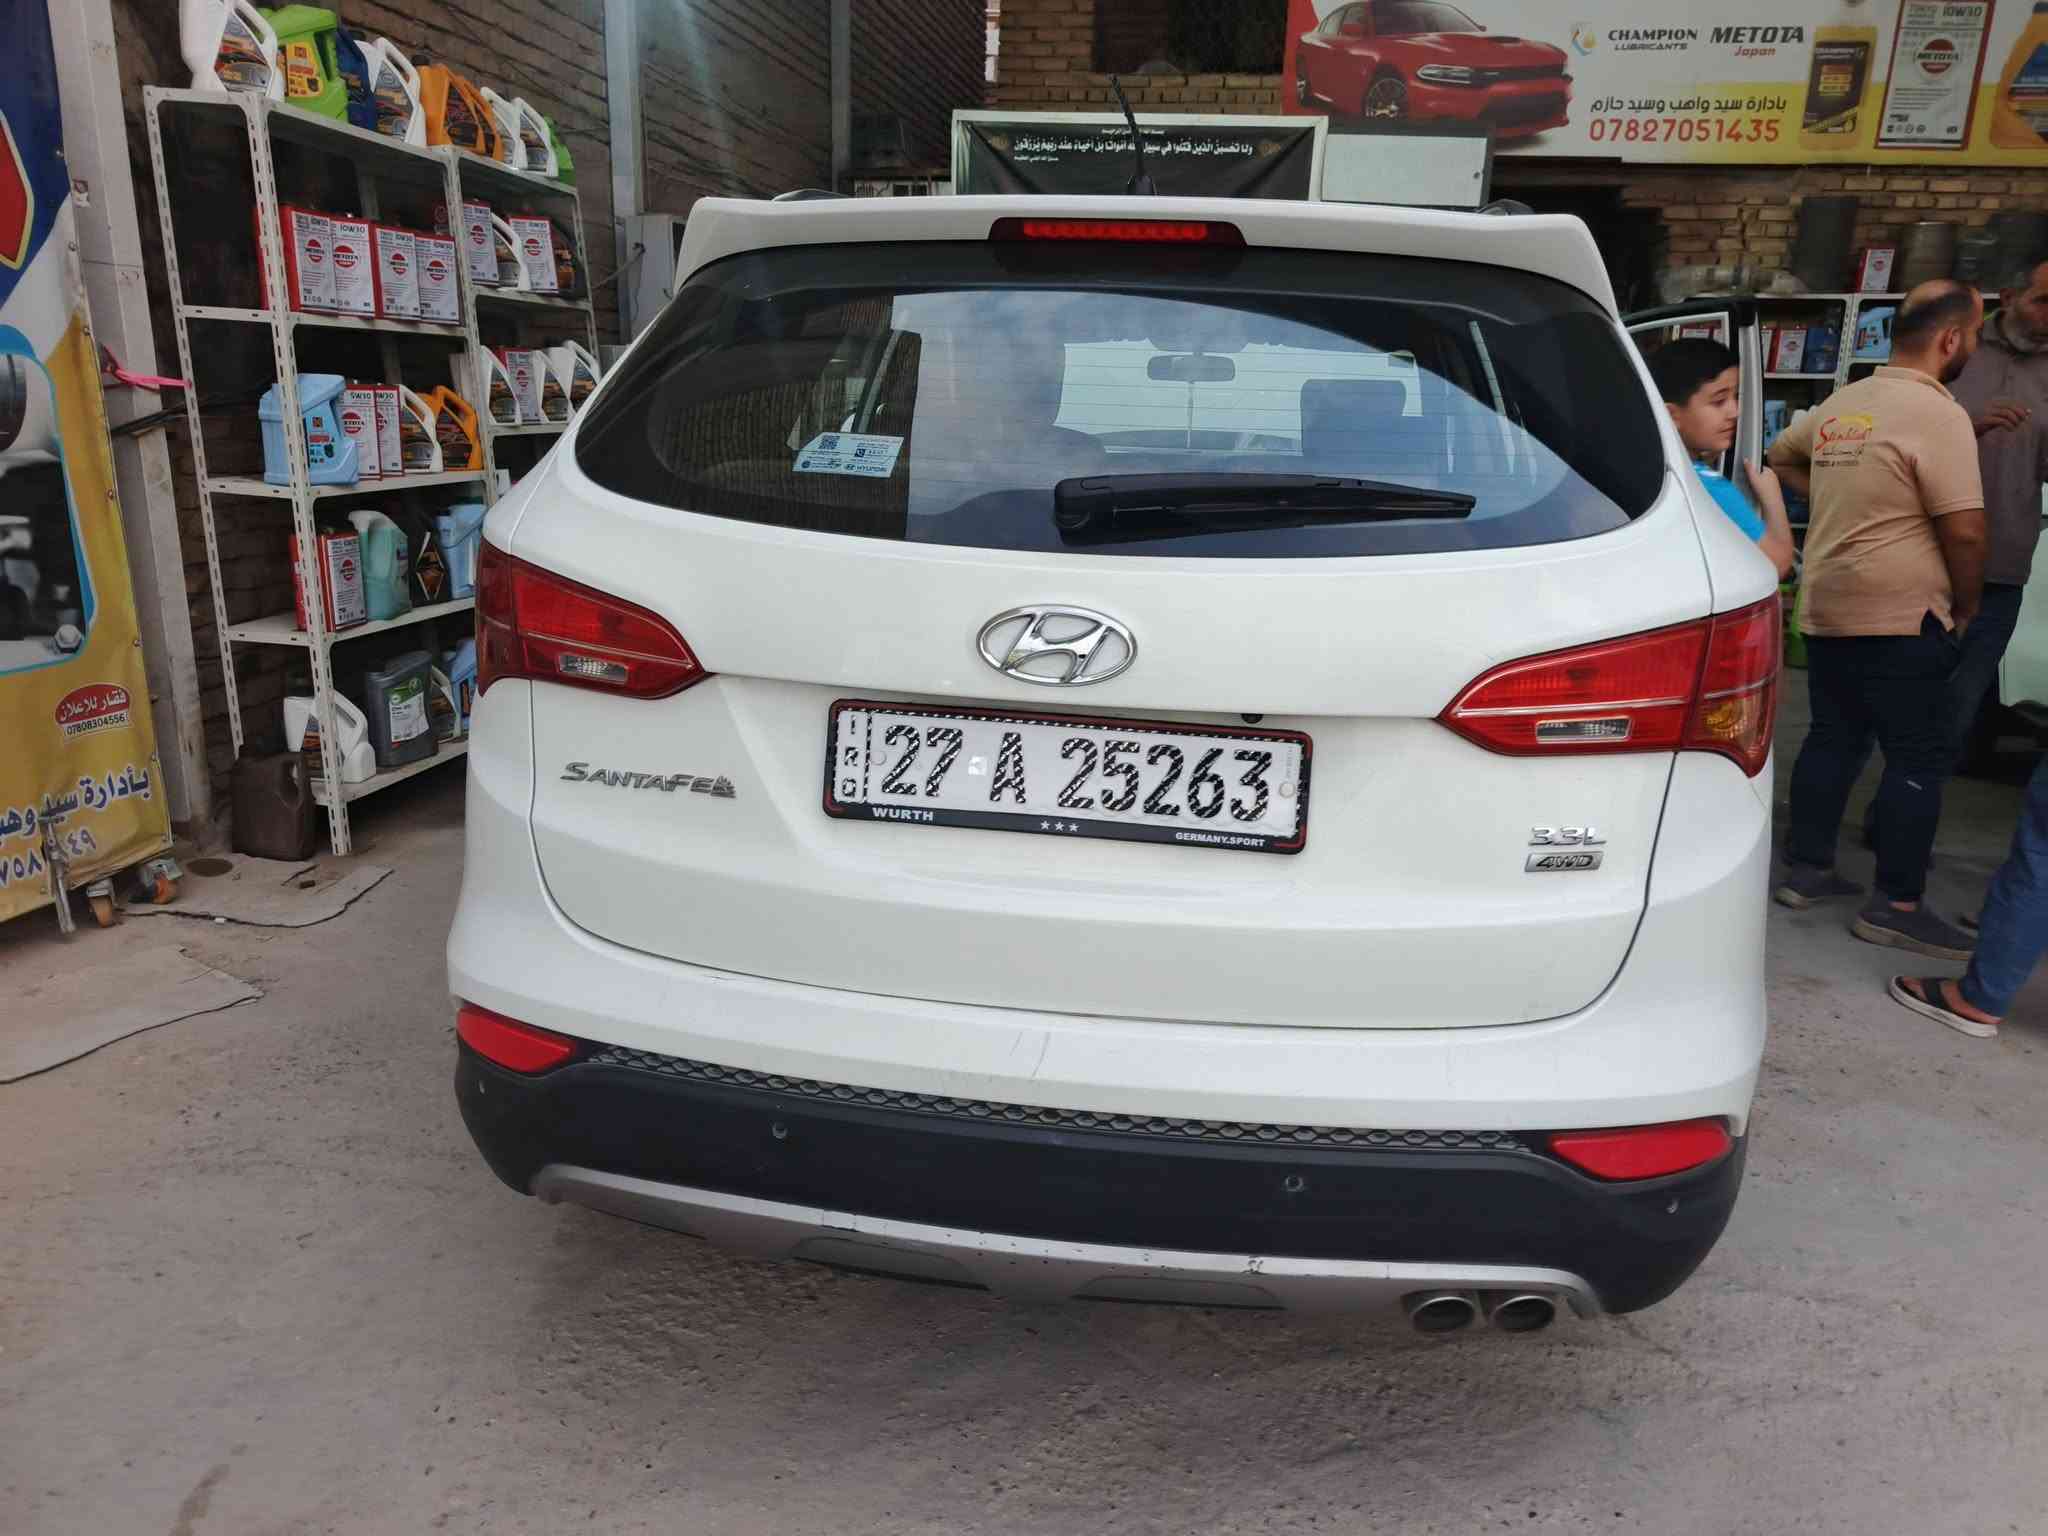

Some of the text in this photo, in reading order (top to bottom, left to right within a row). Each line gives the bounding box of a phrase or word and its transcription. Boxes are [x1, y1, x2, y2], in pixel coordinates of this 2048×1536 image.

[1608, 28, 1698, 42] CHAMPION
[1710, 26, 1805, 45] METOTA
[1614, 43, 1689, 52] LUBRICANTS
[1734, 46, 1777, 59] Japan
[1628, 98, 1666, 113] وسيد
[1669, 97, 1710, 113] واهب
[1713, 97, 1743, 112] سيد
[1588, 118, 1781, 143] 07827051435
[340, 223, 366, 234] 10W30
[881, 724, 963, 797] 27
[990, 732, 1026, 804] A
[1057, 737, 1273, 822] 25263
[872, 807, 935, 821] WURTH
[1535, 854, 1595, 869] 4WD
